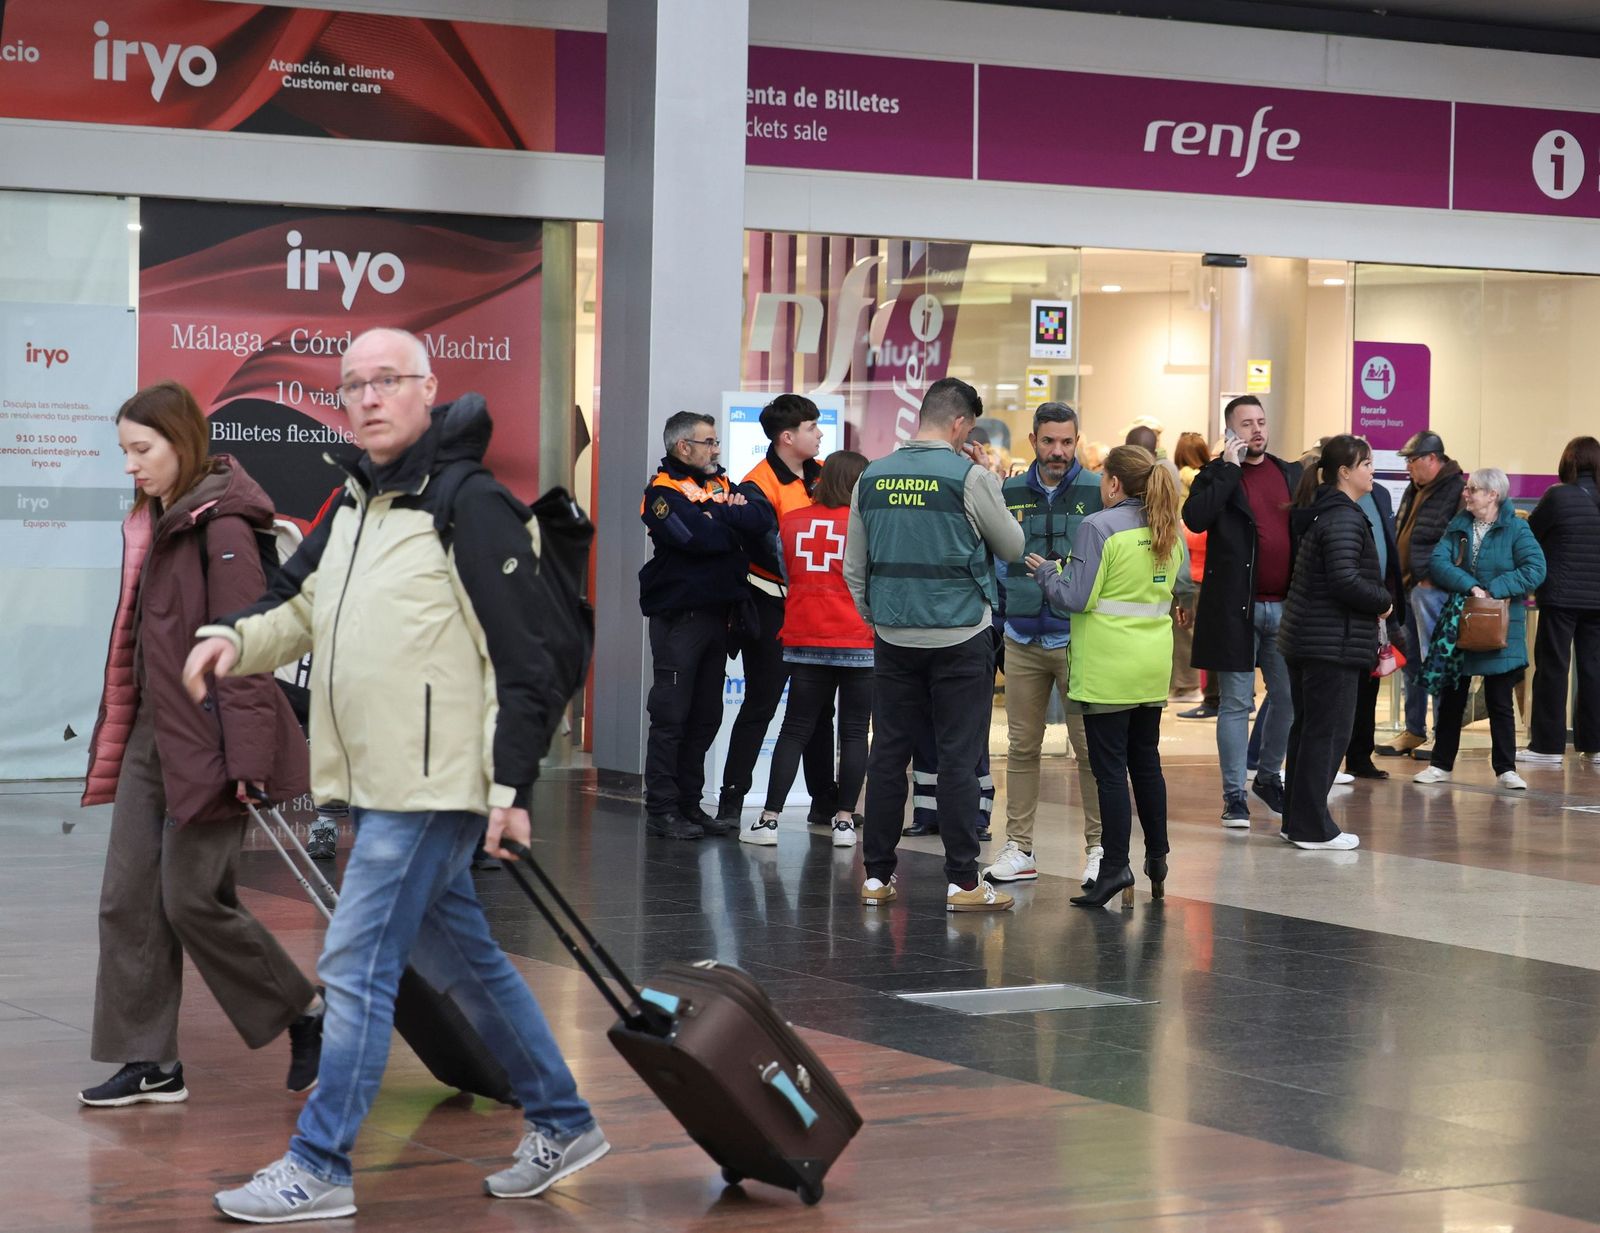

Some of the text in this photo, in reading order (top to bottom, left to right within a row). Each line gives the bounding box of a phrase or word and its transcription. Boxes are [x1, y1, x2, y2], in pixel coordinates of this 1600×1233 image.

[0, 40, 40, 62] cio
[93, 21, 217, 103] iryo
[268, 58, 395, 81] Atención al cliente
[282, 75, 382, 94] Customer care
[793, 86, 818, 108] de
[824, 88, 900, 114] Billetes
[793, 119, 828, 142] sale
[1143, 105, 1301, 178] renfe
[286, 229, 406, 311] iryo
[170, 323, 265, 358] Málaga
[424, 333, 511, 361] Madrid
[26, 342, 70, 369] iryo
[274, 380, 304, 405] 10
[3, 400, 37, 410] Disculpa
[38, 400, 51, 409] las
[1360, 405, 1387, 415] Horario
[57, 413, 70, 421] tus
[71, 414, 109, 423] gestiones
[1360, 418, 1404, 428] Opening hours
[15, 434, 78, 444] 910 150 000
[211, 421, 281, 442] Billetes
[31, 459, 62, 469] iryo.eu
[875, 478, 939, 492] GUARDIA
[17, 493, 49, 512] iryo
[888, 493, 926, 506] CIVIL
[23, 519, 50, 529] Equipo
